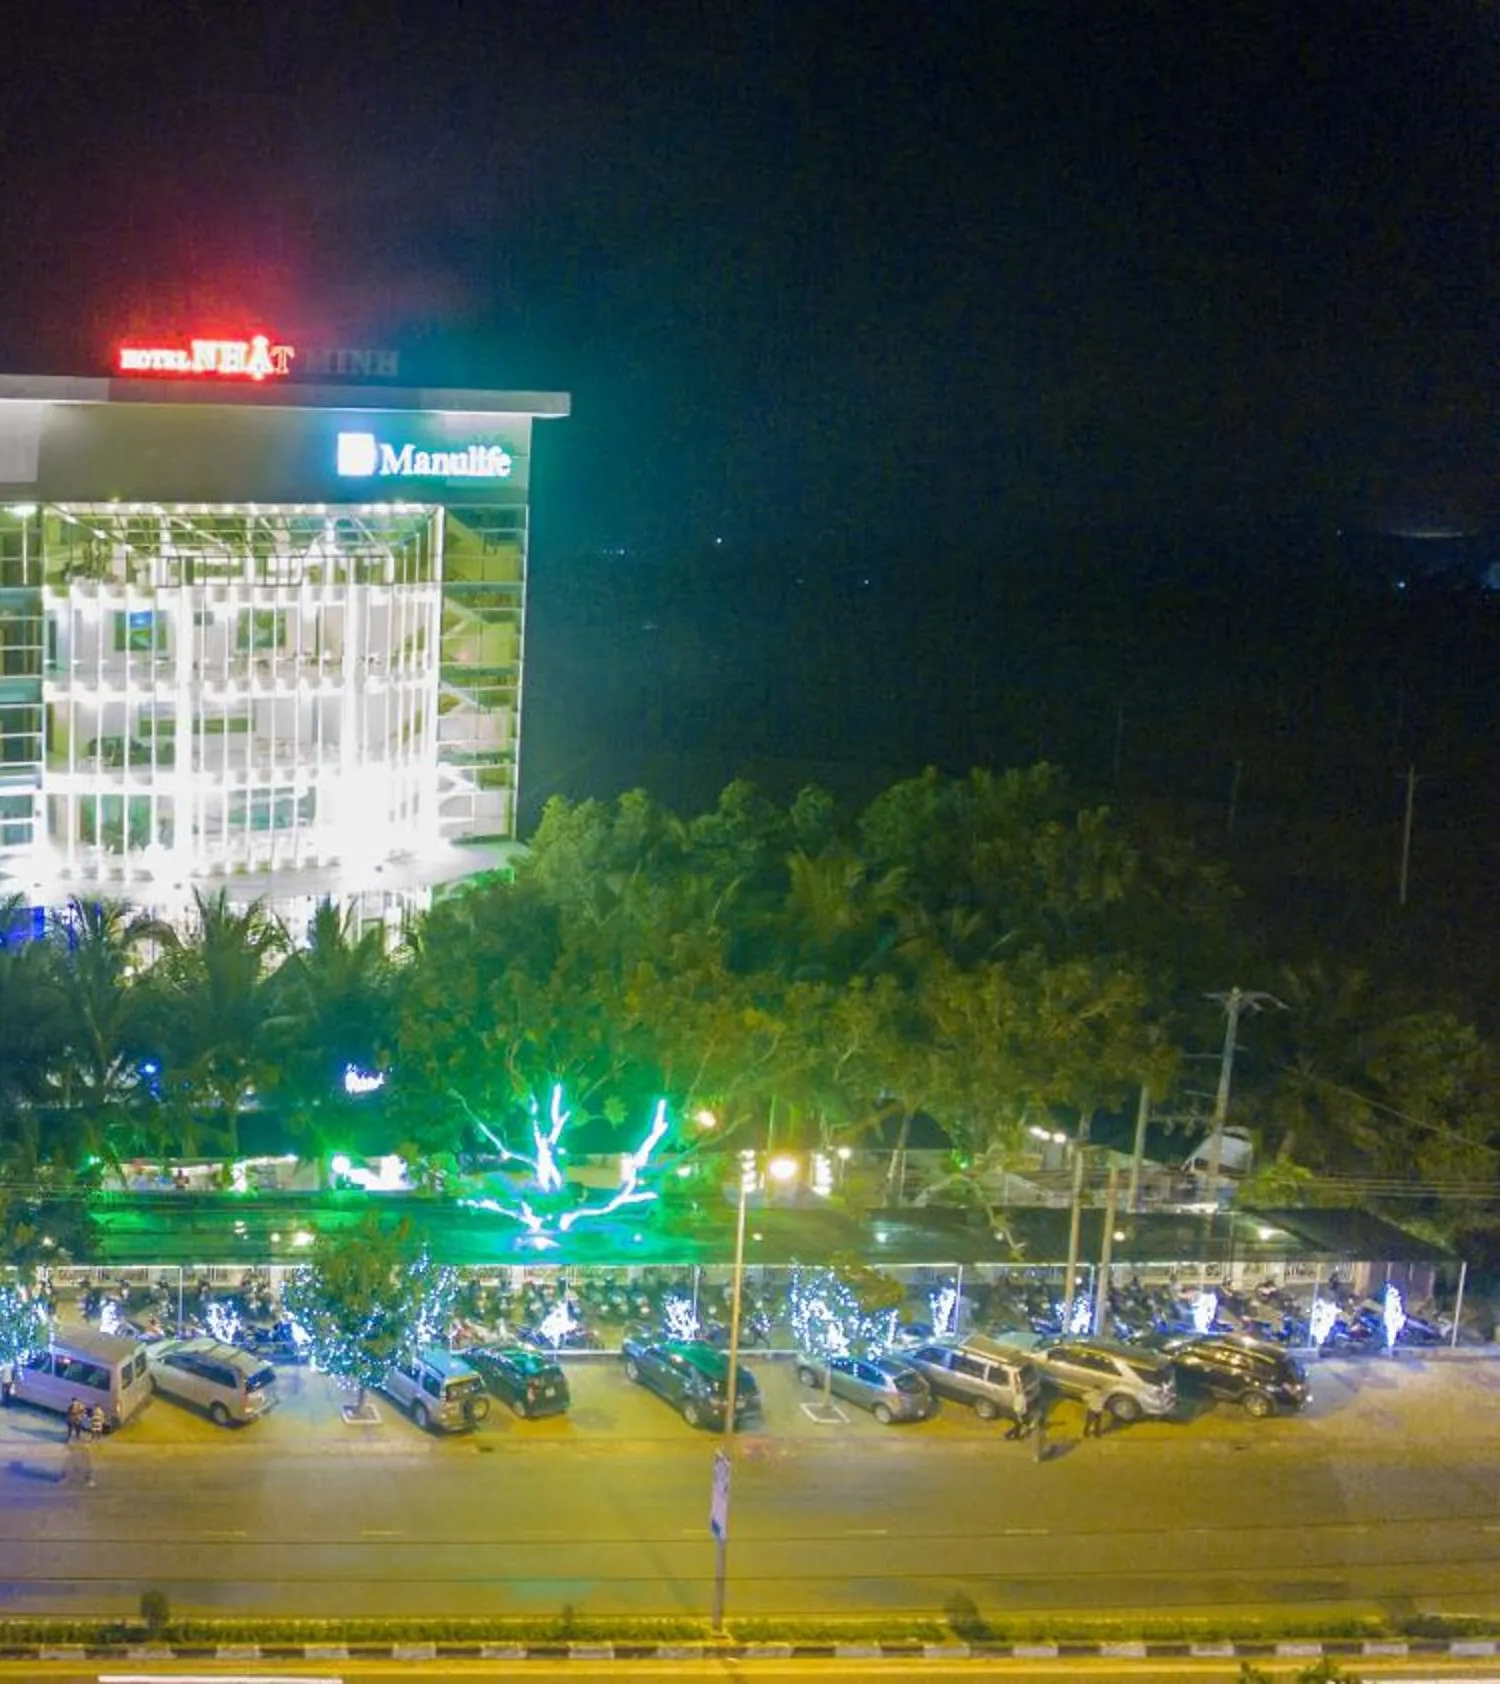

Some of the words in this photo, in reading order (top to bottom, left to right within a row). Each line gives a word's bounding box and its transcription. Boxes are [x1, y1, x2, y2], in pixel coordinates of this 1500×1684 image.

[120, 349, 190, 370] HOTEL
[191, 335, 295, 379] NHẬT
[379, 443, 511, 477] Manulife
